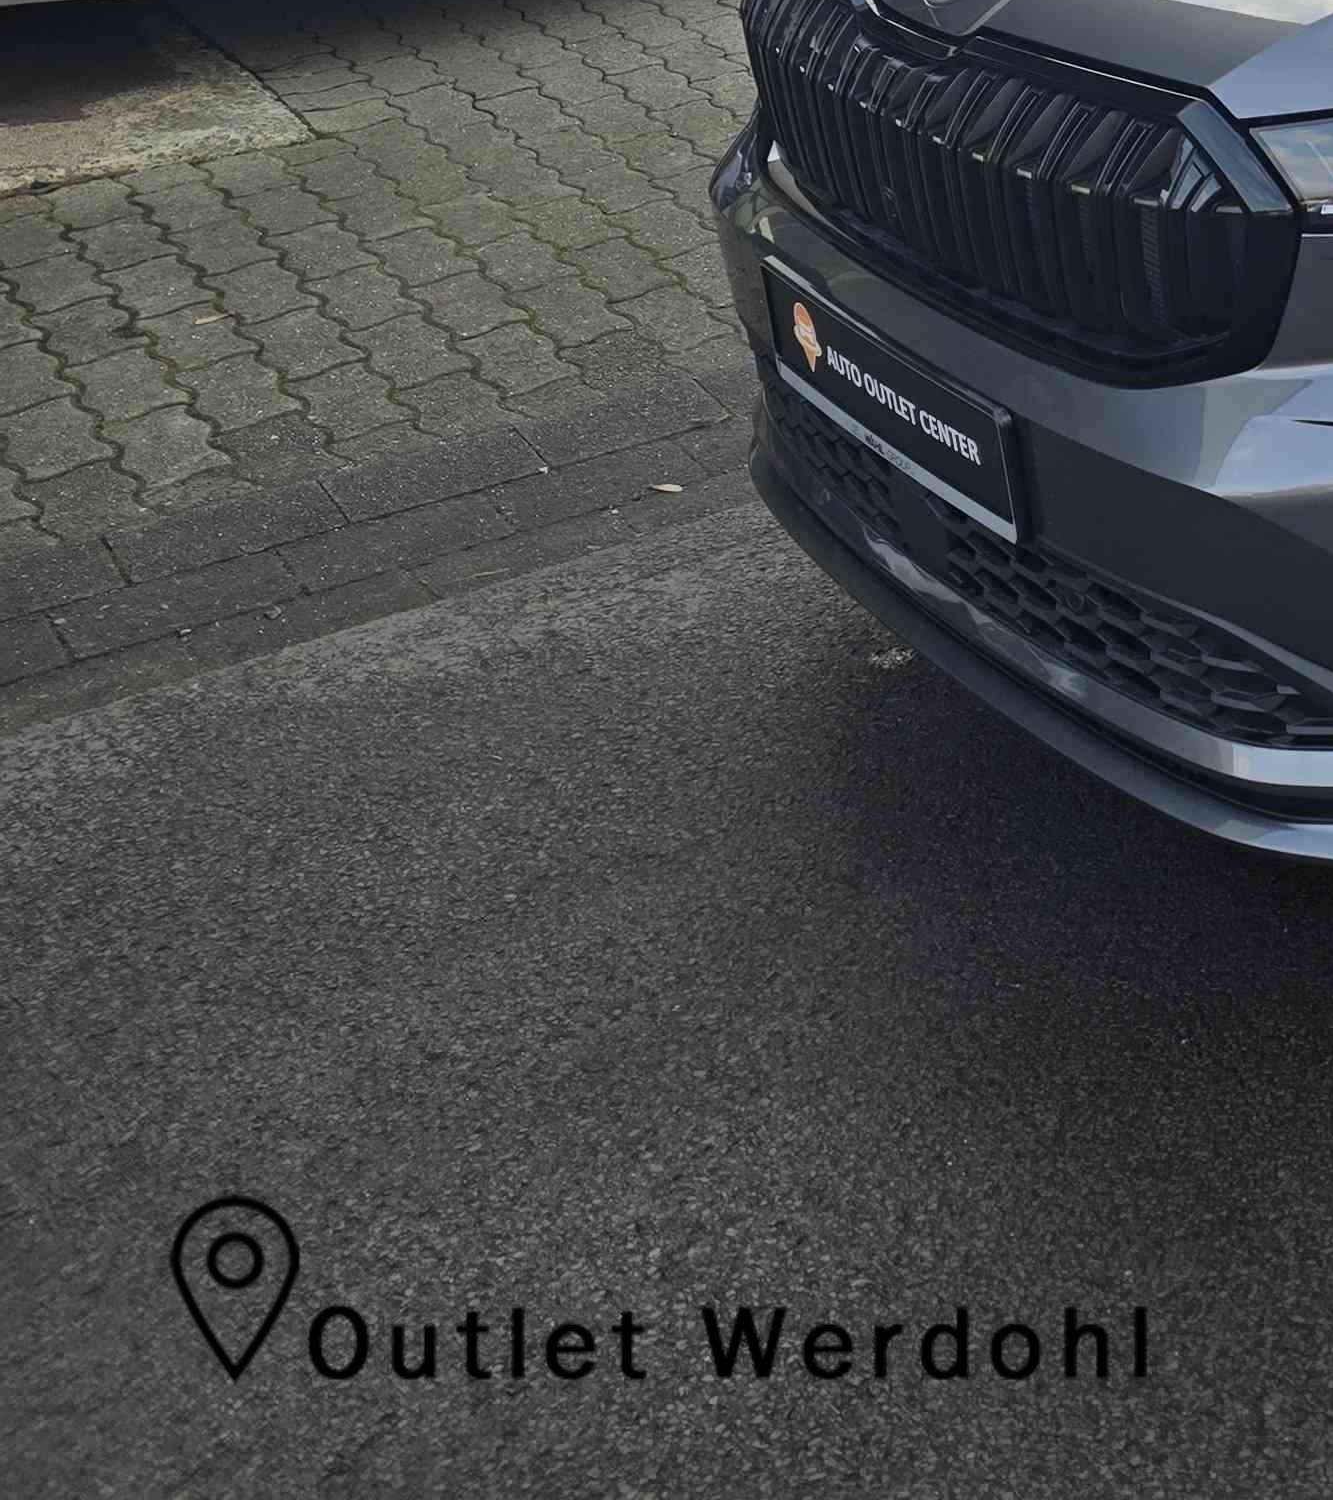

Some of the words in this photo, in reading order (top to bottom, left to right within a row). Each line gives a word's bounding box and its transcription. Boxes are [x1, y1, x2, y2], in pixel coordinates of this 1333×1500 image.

[826, 345, 863, 388] AUTO
[863, 372, 917, 426] OUTLET
[919, 409, 982, 466] CENTER
